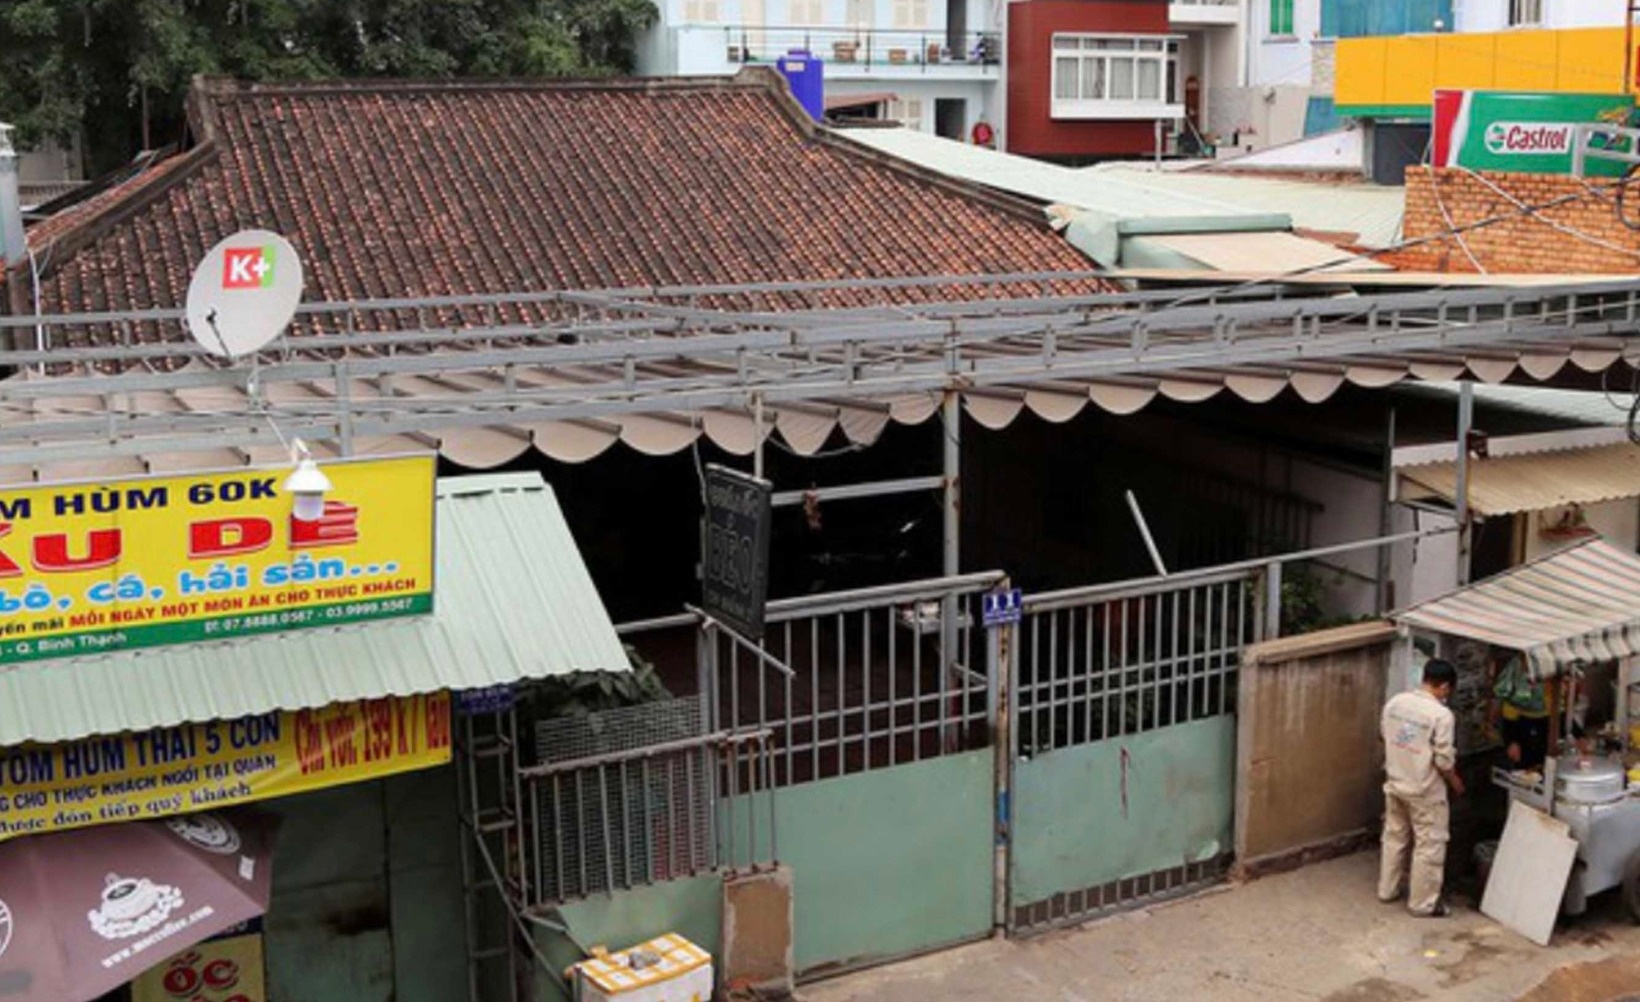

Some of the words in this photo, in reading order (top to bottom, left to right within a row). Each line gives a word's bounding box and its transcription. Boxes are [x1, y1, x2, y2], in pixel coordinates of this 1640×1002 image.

[1506, 126, 1567, 150] Castrol
[230, 253, 270, 282] K+
[54, 486, 168, 516] HÙM
[188, 477, 277, 504] 60K
[180, 562, 248, 594] hải
[276, 589, 310, 605] CHO
[206, 718, 221, 755] 5
[13, 790, 48, 809] CHO
